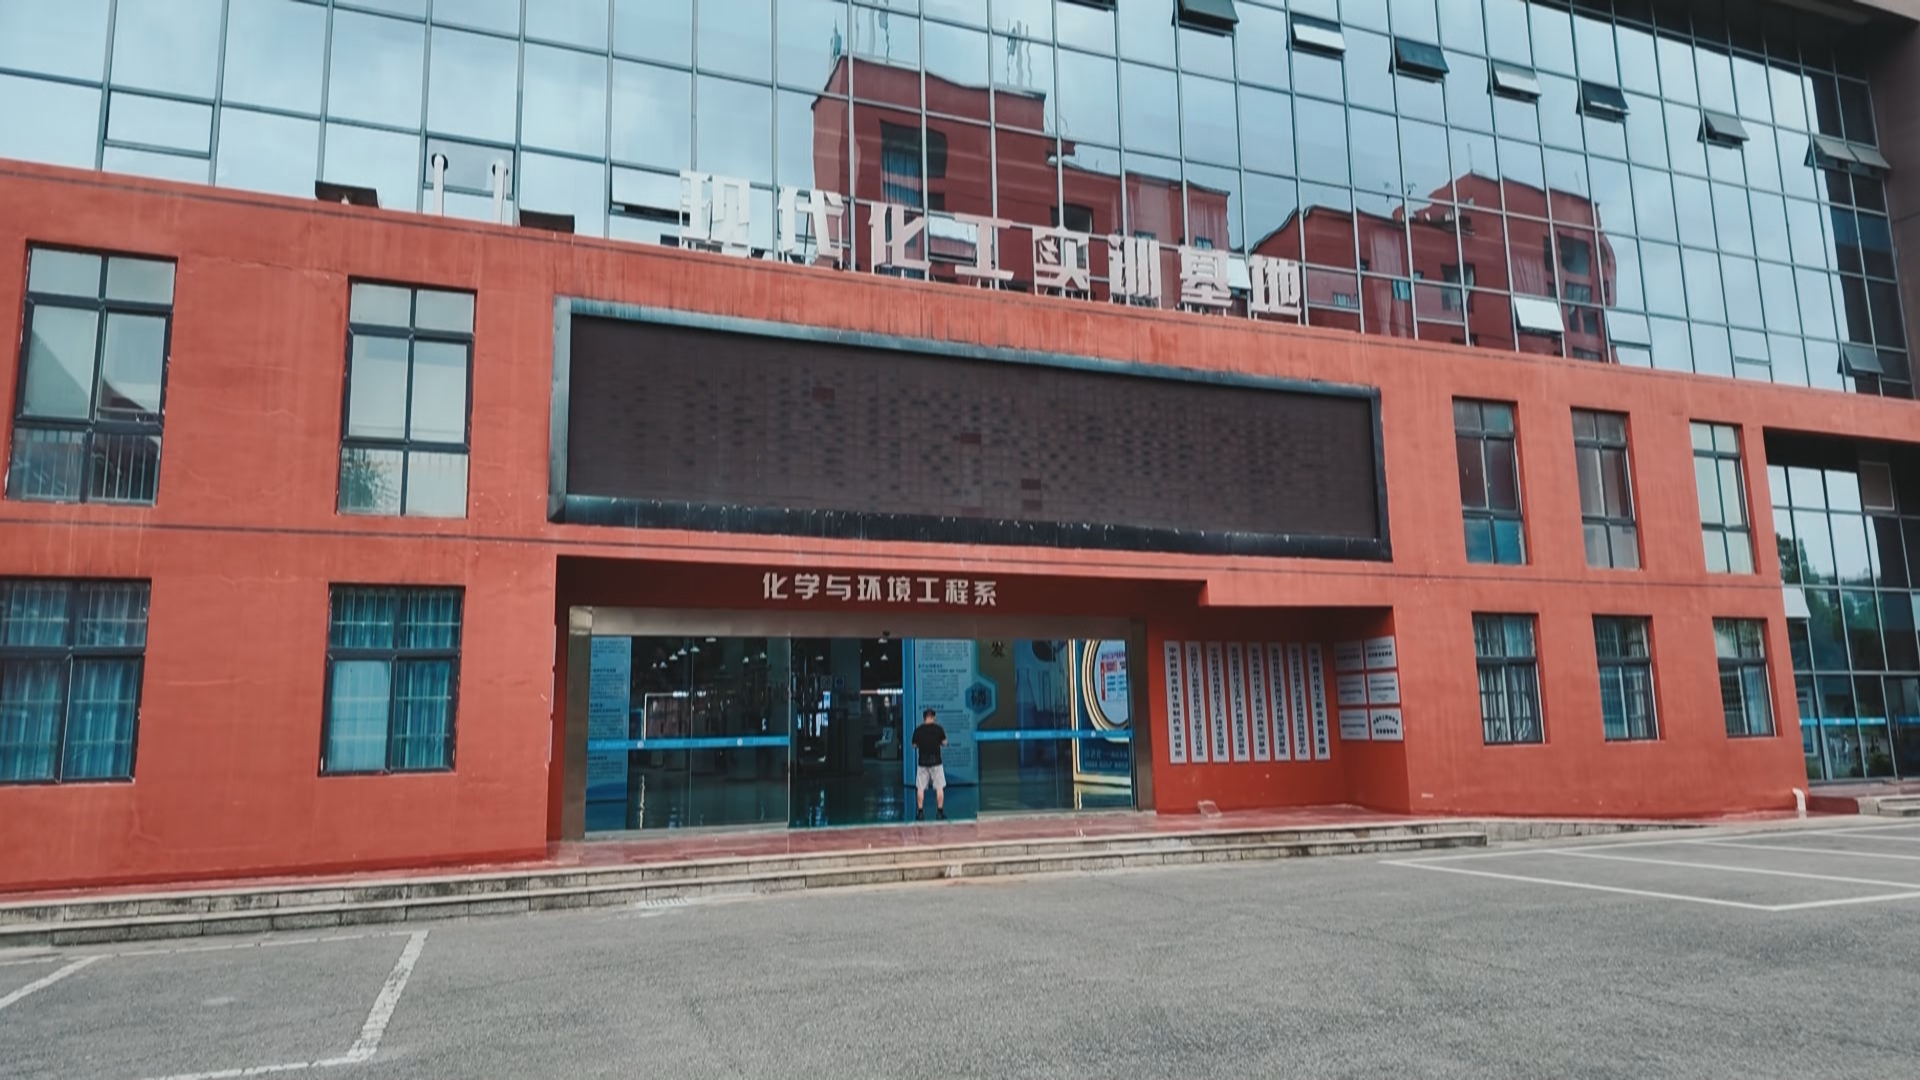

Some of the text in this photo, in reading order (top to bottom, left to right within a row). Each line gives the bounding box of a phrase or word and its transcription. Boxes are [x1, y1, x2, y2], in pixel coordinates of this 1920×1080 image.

[680, 171, 1301, 316] 现代化工实训基地
[763, 572, 997, 606] 化学与环境工程系
